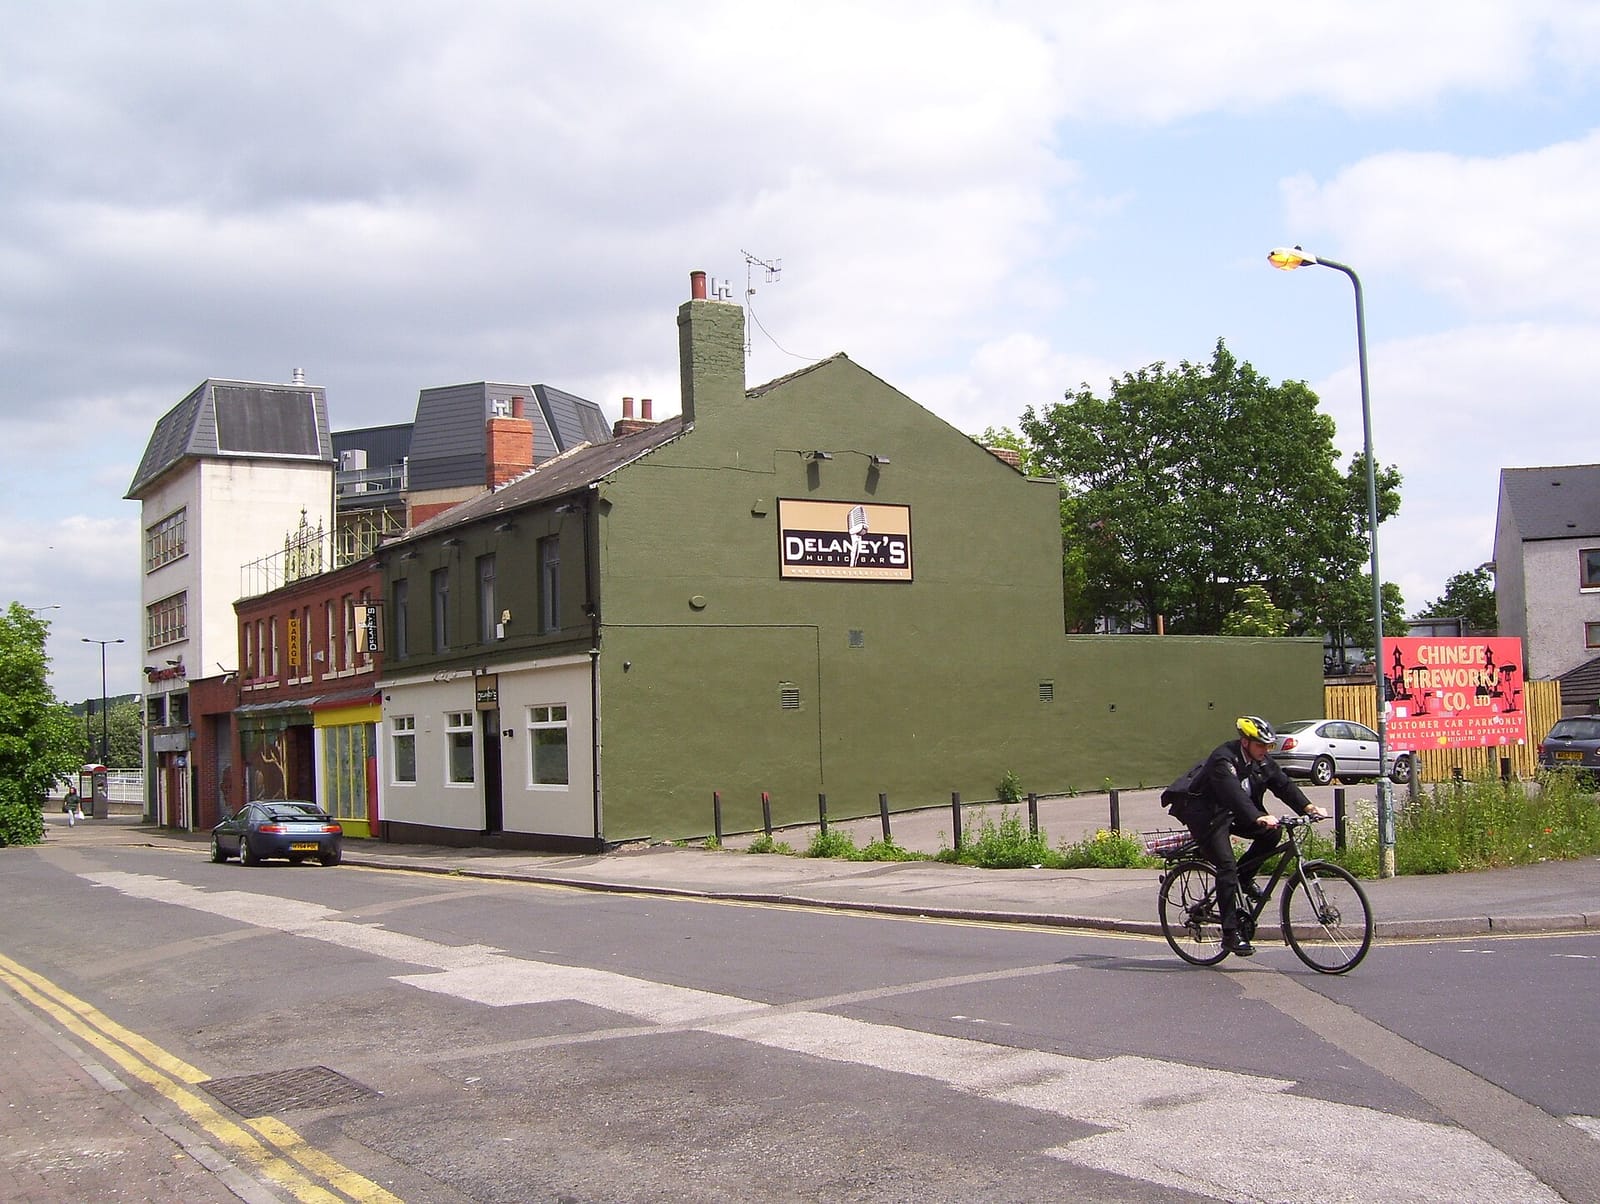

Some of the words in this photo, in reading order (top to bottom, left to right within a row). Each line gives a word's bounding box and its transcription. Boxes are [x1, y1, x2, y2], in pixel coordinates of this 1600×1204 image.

[785, 536, 905, 564] DELANEY'S
[806, 554, 849, 562] MUSIC
[1416, 645, 1487, 665] CHINESE
[1403, 668, 1500, 689] FIREWORKS
[1443, 692, 1471, 711] CO.
[1473, 694, 1490, 706] LTD
[1444, 719, 1463, 728] CAR
[1468, 718, 1493, 727] PARK
[1498, 717, 1522, 726] ONLY
[1420, 730, 1461, 738] CLAMPING
